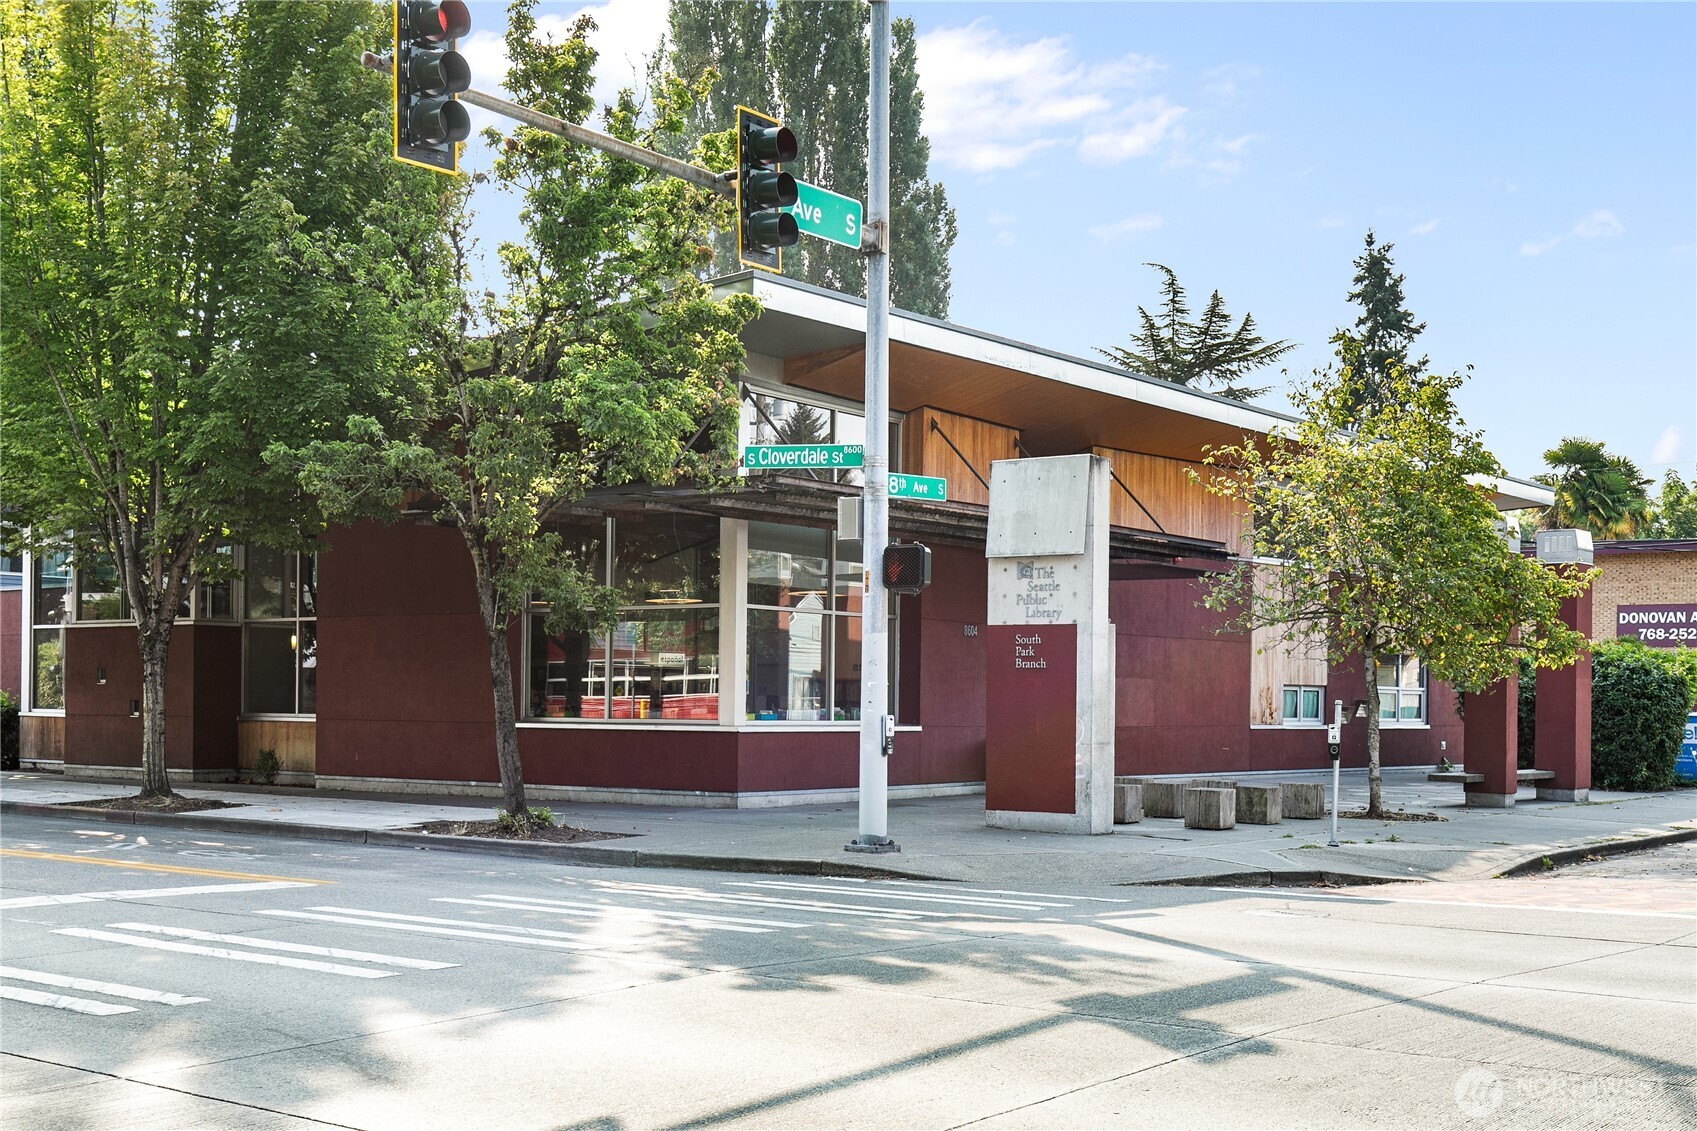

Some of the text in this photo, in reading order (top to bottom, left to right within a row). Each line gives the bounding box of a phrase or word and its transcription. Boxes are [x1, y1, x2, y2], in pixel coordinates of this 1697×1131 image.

[791, 196, 857, 235] Ave S
[843, 445, 862, 454] 8600
[747, 447, 844, 466] S Cloverdale St
[888, 476, 944, 496] 8th Ave S
[1035, 566, 1055, 579] The
[1027, 580, 1061, 593] Seattle
[1016, 593, 1047, 606] Public
[1025, 606, 1063, 621] Library
[1619, 611, 1687, 624] DONOVAN
[963, 624, 978, 637] 8604
[1015, 633, 1042, 645] South
[1015, 646, 1035, 656] Park
[1015, 658, 1047, 669] Branch
